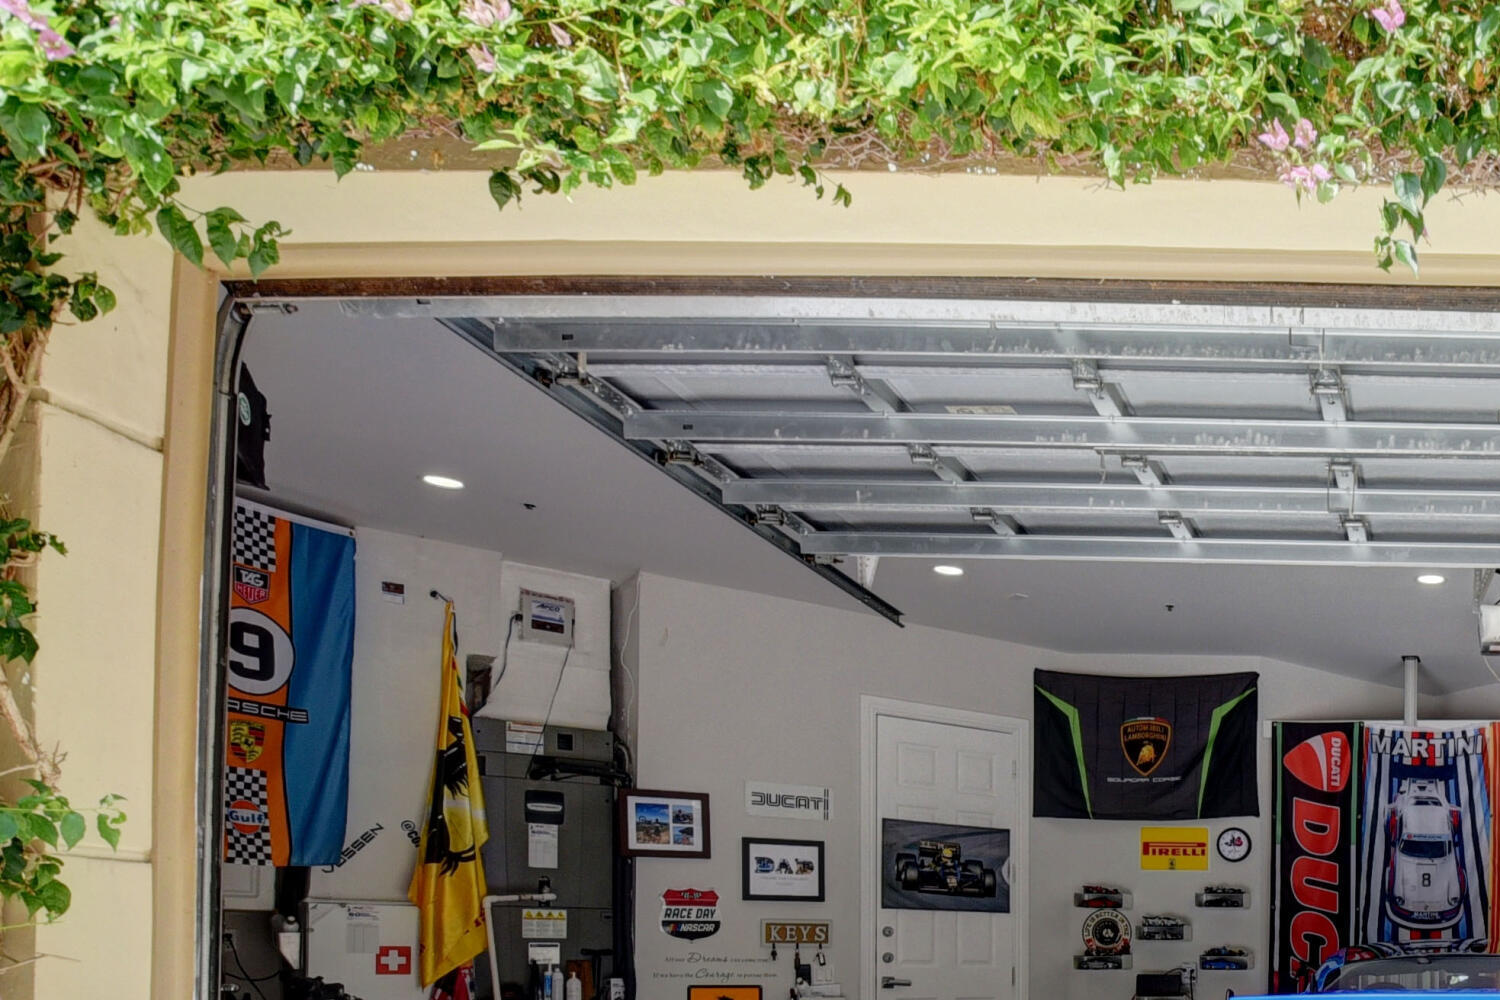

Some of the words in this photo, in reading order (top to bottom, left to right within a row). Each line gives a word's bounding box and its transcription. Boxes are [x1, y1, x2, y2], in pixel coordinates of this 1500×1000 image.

[240, 570, 264, 587] TAG
[236, 583, 266, 601] HEUER
[229, 621, 275, 682] 9
[227, 699, 308, 722] RSCHE
[1371, 733, 1483, 759] MARTINI
[1330, 736, 1342, 787] DUCATI
[751, 788, 829, 821] DUCATI
[229, 810, 265, 824] Gulf
[1143, 841, 1207, 856] PIRELLI
[754, 856, 815, 875] DAD
[1421, 872, 1432, 887] 8
[664, 908, 693, 919] RACE
[696, 908, 716, 919] DAY
[680, 923, 716, 932] NASCAR
[770, 925, 827, 942] KEYS
[687, 952, 728, 963] Dreams
